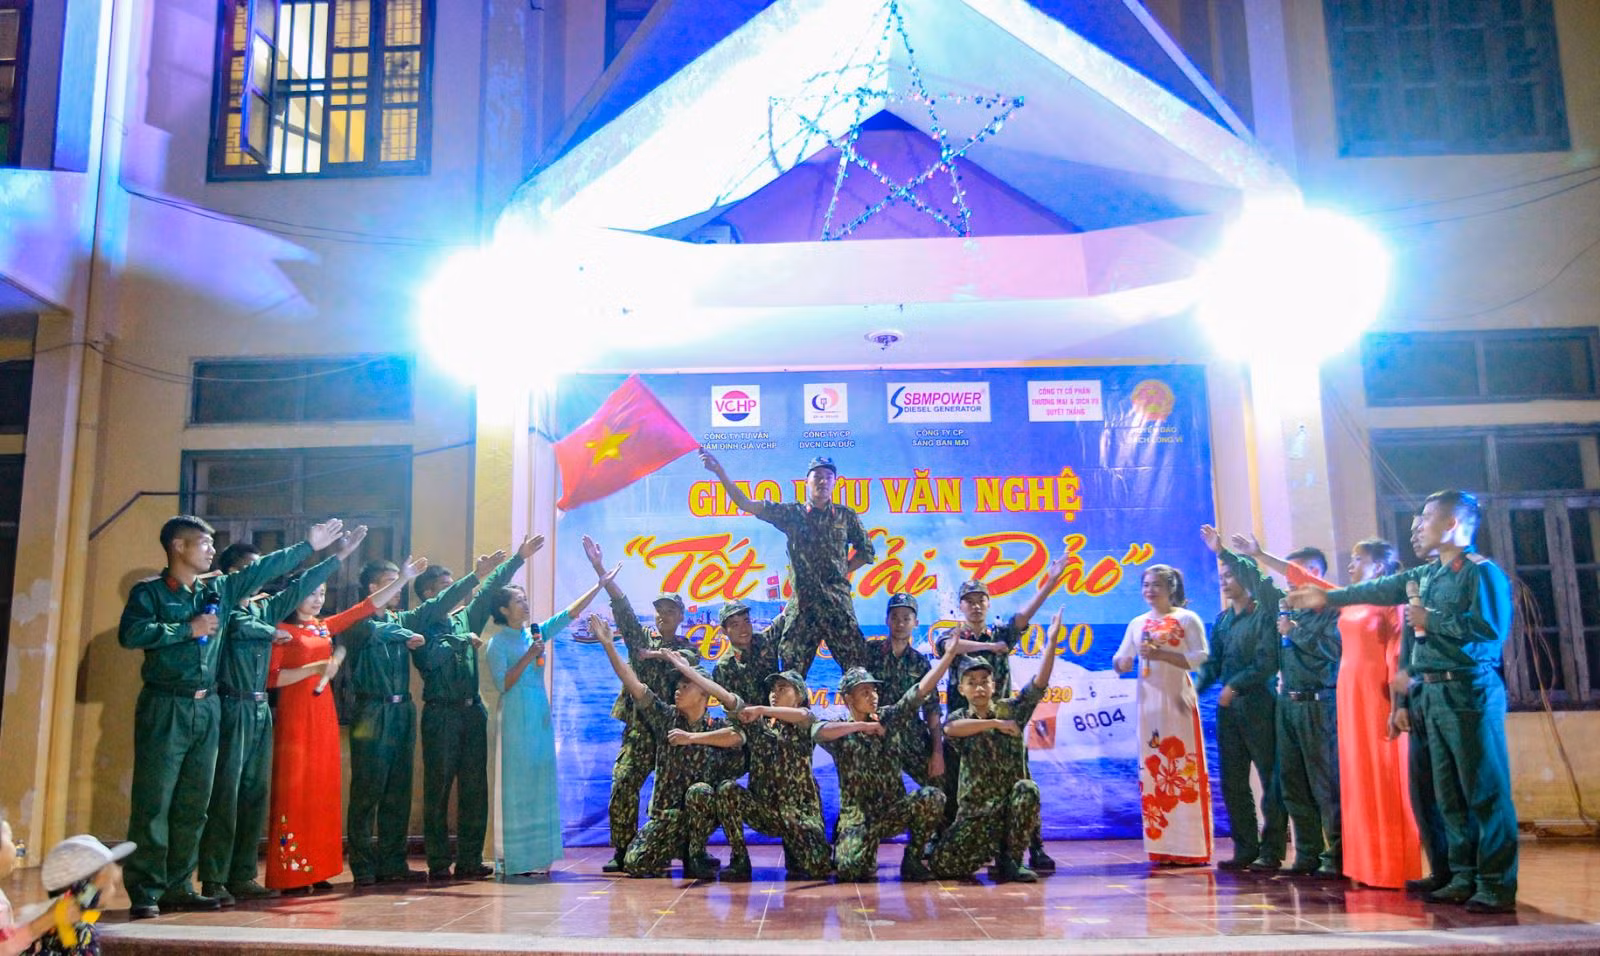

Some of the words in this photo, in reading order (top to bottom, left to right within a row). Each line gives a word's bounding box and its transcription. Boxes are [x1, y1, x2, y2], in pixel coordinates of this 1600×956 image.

[1039, 387, 1055, 395] CÔNG
[904, 392, 982, 405] SBMPOWER
[715, 400, 757, 412] VCHP
[933, 405, 982, 413] GENERATOR
[703, 431, 727, 440] CÔNG
[729, 432, 739, 440] TY
[803, 430, 826, 438] CÔNG
[915, 429, 939, 437] CÔNG
[700, 441, 718, 450] HẨM
[756, 441, 777, 450] VCHP
[799, 441, 821, 449] DVCN
[689, 480, 782, 517] GIAO
[879, 468, 963, 513] VĂN
[973, 466, 1082, 522] NGHỆ
[1009, 623, 1094, 656] 020
[1073, 708, 1125, 731] 8004
